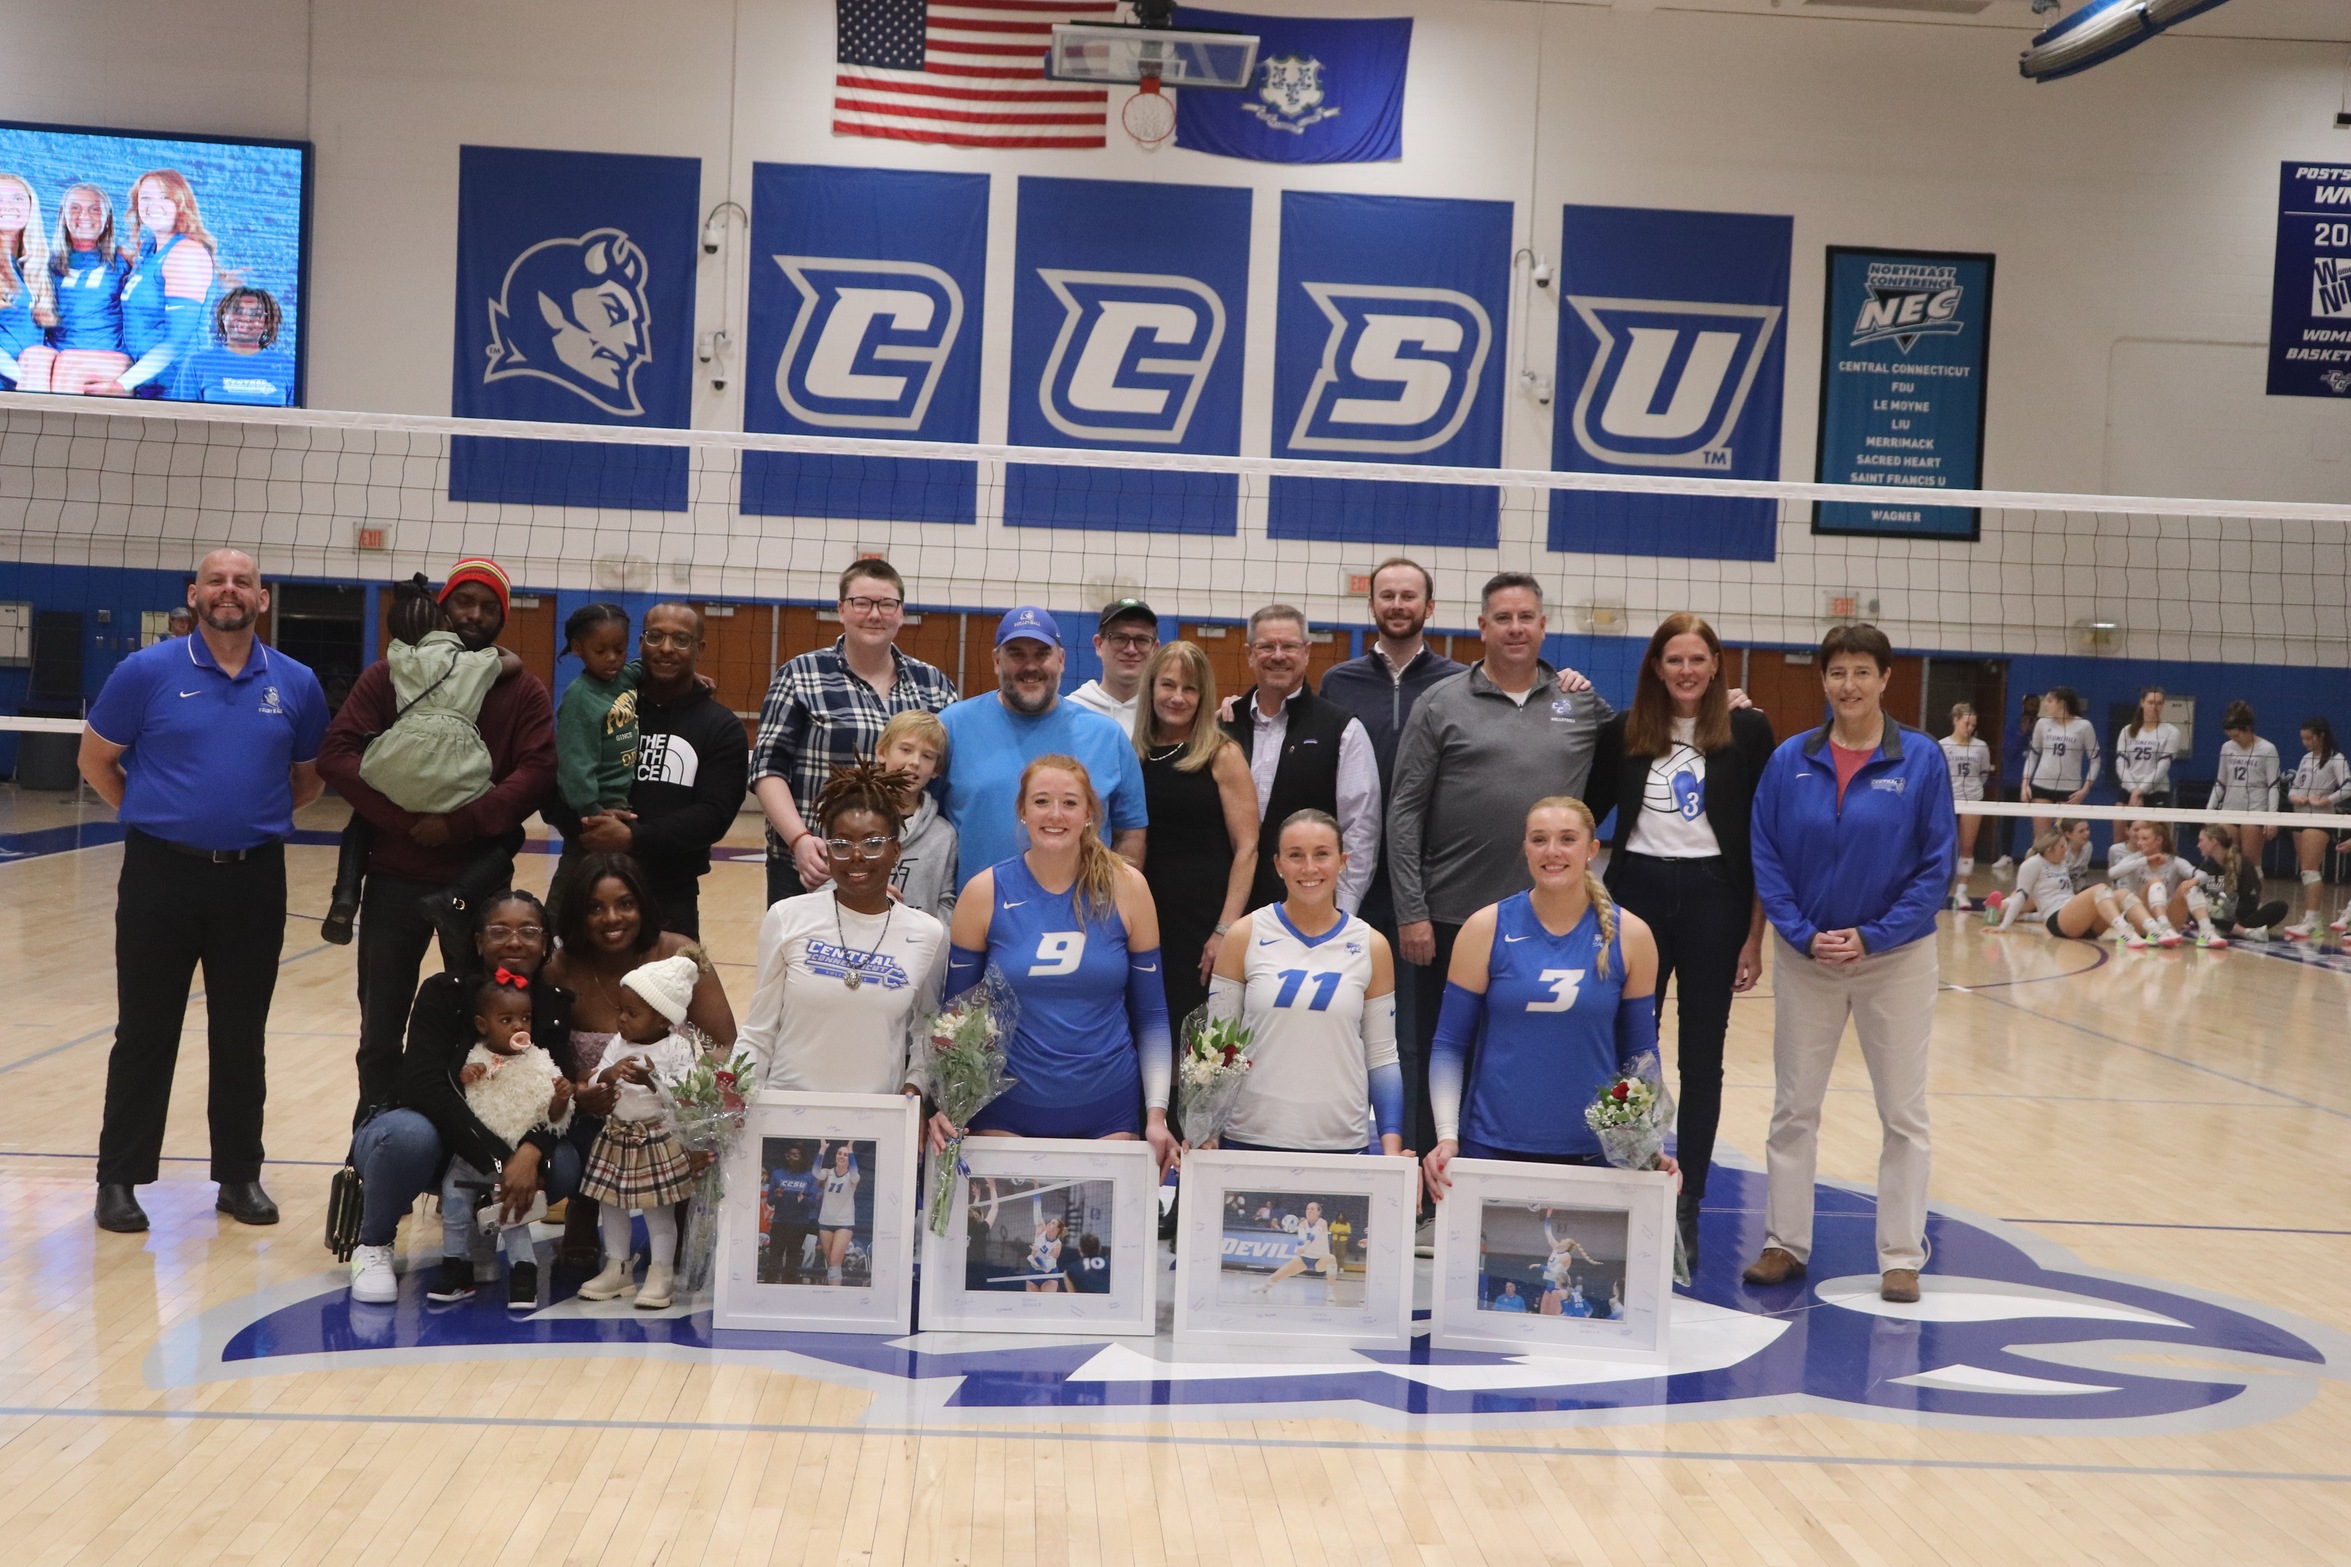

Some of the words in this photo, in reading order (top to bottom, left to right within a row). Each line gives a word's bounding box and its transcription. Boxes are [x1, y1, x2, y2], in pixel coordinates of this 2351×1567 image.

[2314, 222, 2351, 247] 20
[60, 266, 107, 289] 11
[1869, 263, 1956, 279] NORTHEAST
[1868, 275, 1954, 288] CONFERENCE
[1856, 289, 1959, 331] NEC
[1839, 360, 1889, 374] CENTRAL
[1891, 363, 1970, 378] CONNECTICUT
[1891, 381, 1915, 393] FDU
[1873, 399, 1888, 411] LE
[1890, 400, 1931, 413] MOYNE
[1891, 419, 1911, 430] LIU
[1865, 436, 1935, 450] MERRIMACK
[1703, 450, 1727, 465] TM
[1856, 454, 1901, 467] SACRED
[1903, 456, 1942, 468] HEART
[1850, 472, 1884, 484] SAINT
[1886, 473, 1936, 486] FRANCIS
[1937, 475, 1947, 487] U
[1871, 510, 1922, 523] WAGNER
[361, 529, 383, 547] EXIT
[2134, 747, 2153, 761] 25
[2234, 766, 2247, 781] 12
[1683, 792, 1699, 817] 3
[807, 940, 895, 968] CENTRAL
[1027, 930, 1087, 977] 9
[810, 953, 889, 973] CONNEICUT
[1272, 968, 1343, 1012] 11
[1525, 968, 1586, 1013] 3
[781, 1180, 807, 1188] CCSU
[828, 1182, 844, 1194] 11
[1083, 1256, 1106, 1271] 10
